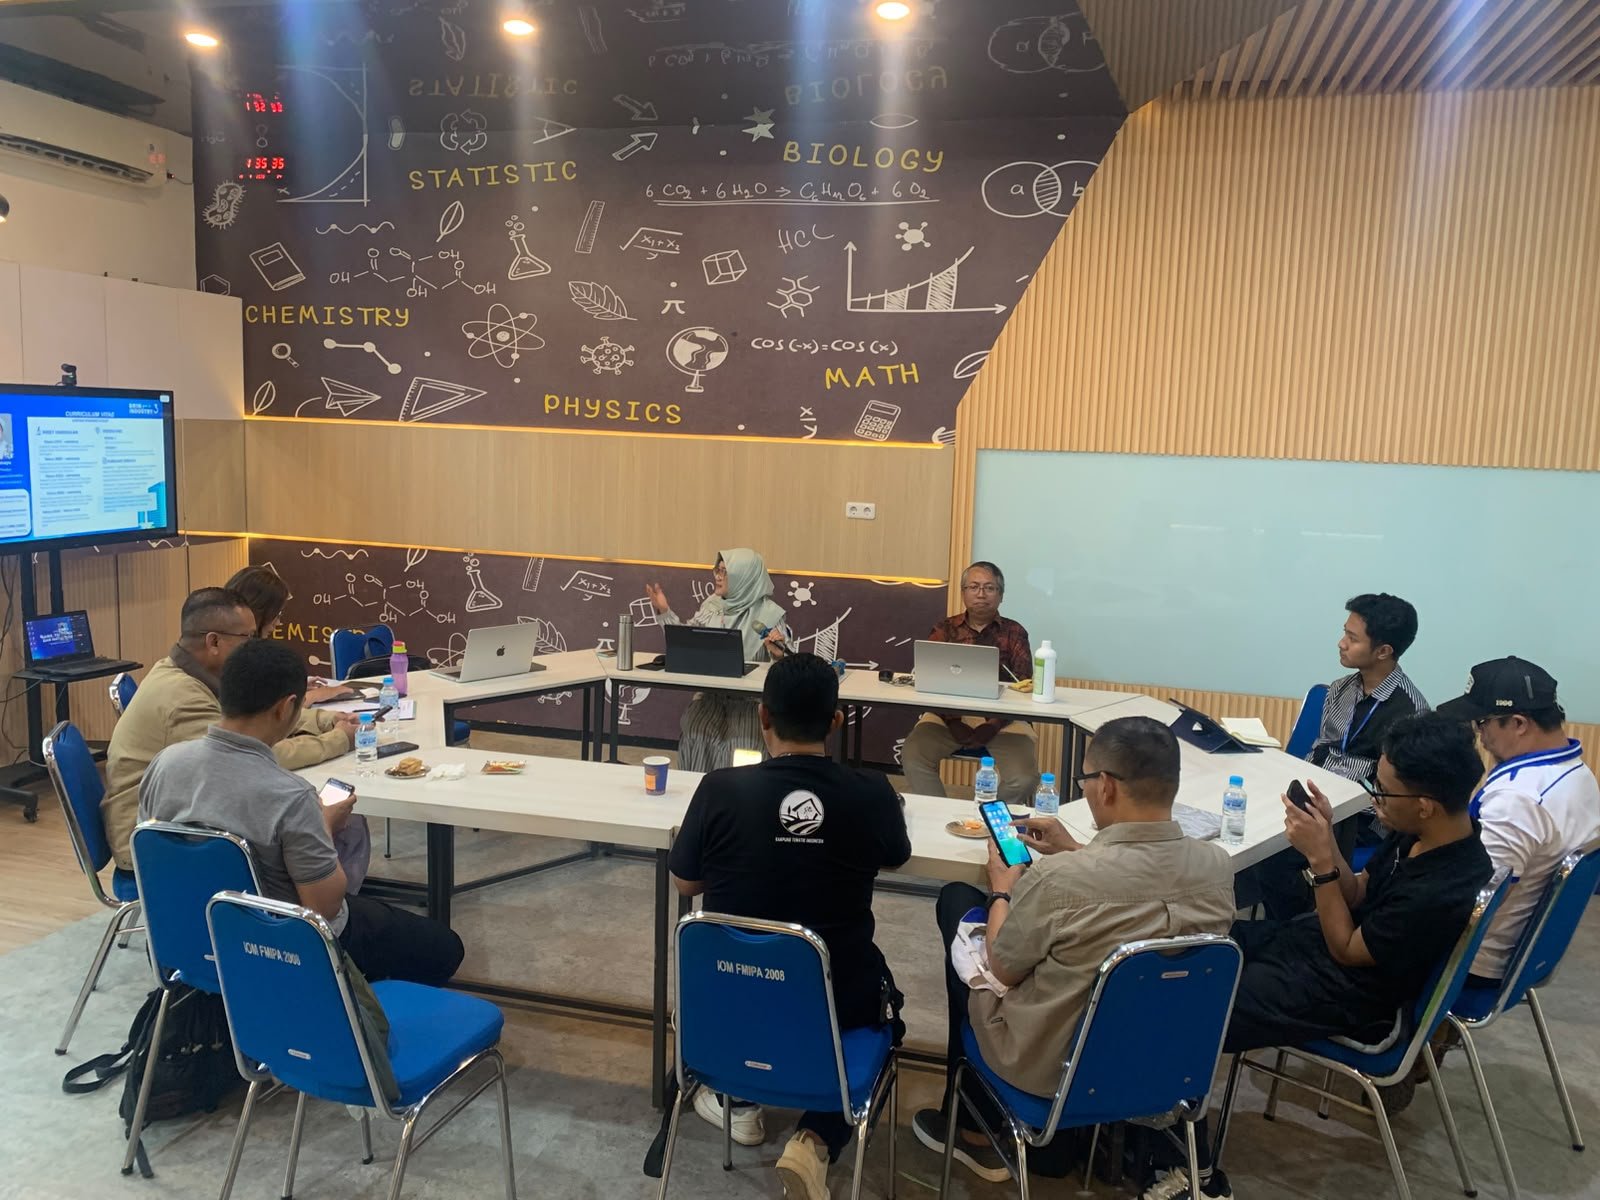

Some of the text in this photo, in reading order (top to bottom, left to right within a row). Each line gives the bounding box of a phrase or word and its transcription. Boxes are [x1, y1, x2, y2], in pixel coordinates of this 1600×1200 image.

[783, 140, 945, 173] BIOLOGY
[408, 160, 578, 191] STATISTIC
[1010, 184, 1025, 196] a
[438, 249, 460, 260] OH
[329, 271, 350, 284] OH
[406, 285, 428, 298] OH
[473, 281, 497, 295] OH
[660, 299, 686, 315] π
[245, 304, 409, 328] CHEMISTRY
[825, 362, 920, 390] MATH
[543, 393, 682, 424] PHYSICS
[406, 579, 425, 589] OH
[313, 593, 331, 605] OH
[379, 610, 398, 623] OH
[436, 612, 456, 624] OH
[243, 941, 259, 957] IOM
[259, 945, 283, 962] FMIPA
[716, 959, 785, 982] IOM FMIPA 2008
